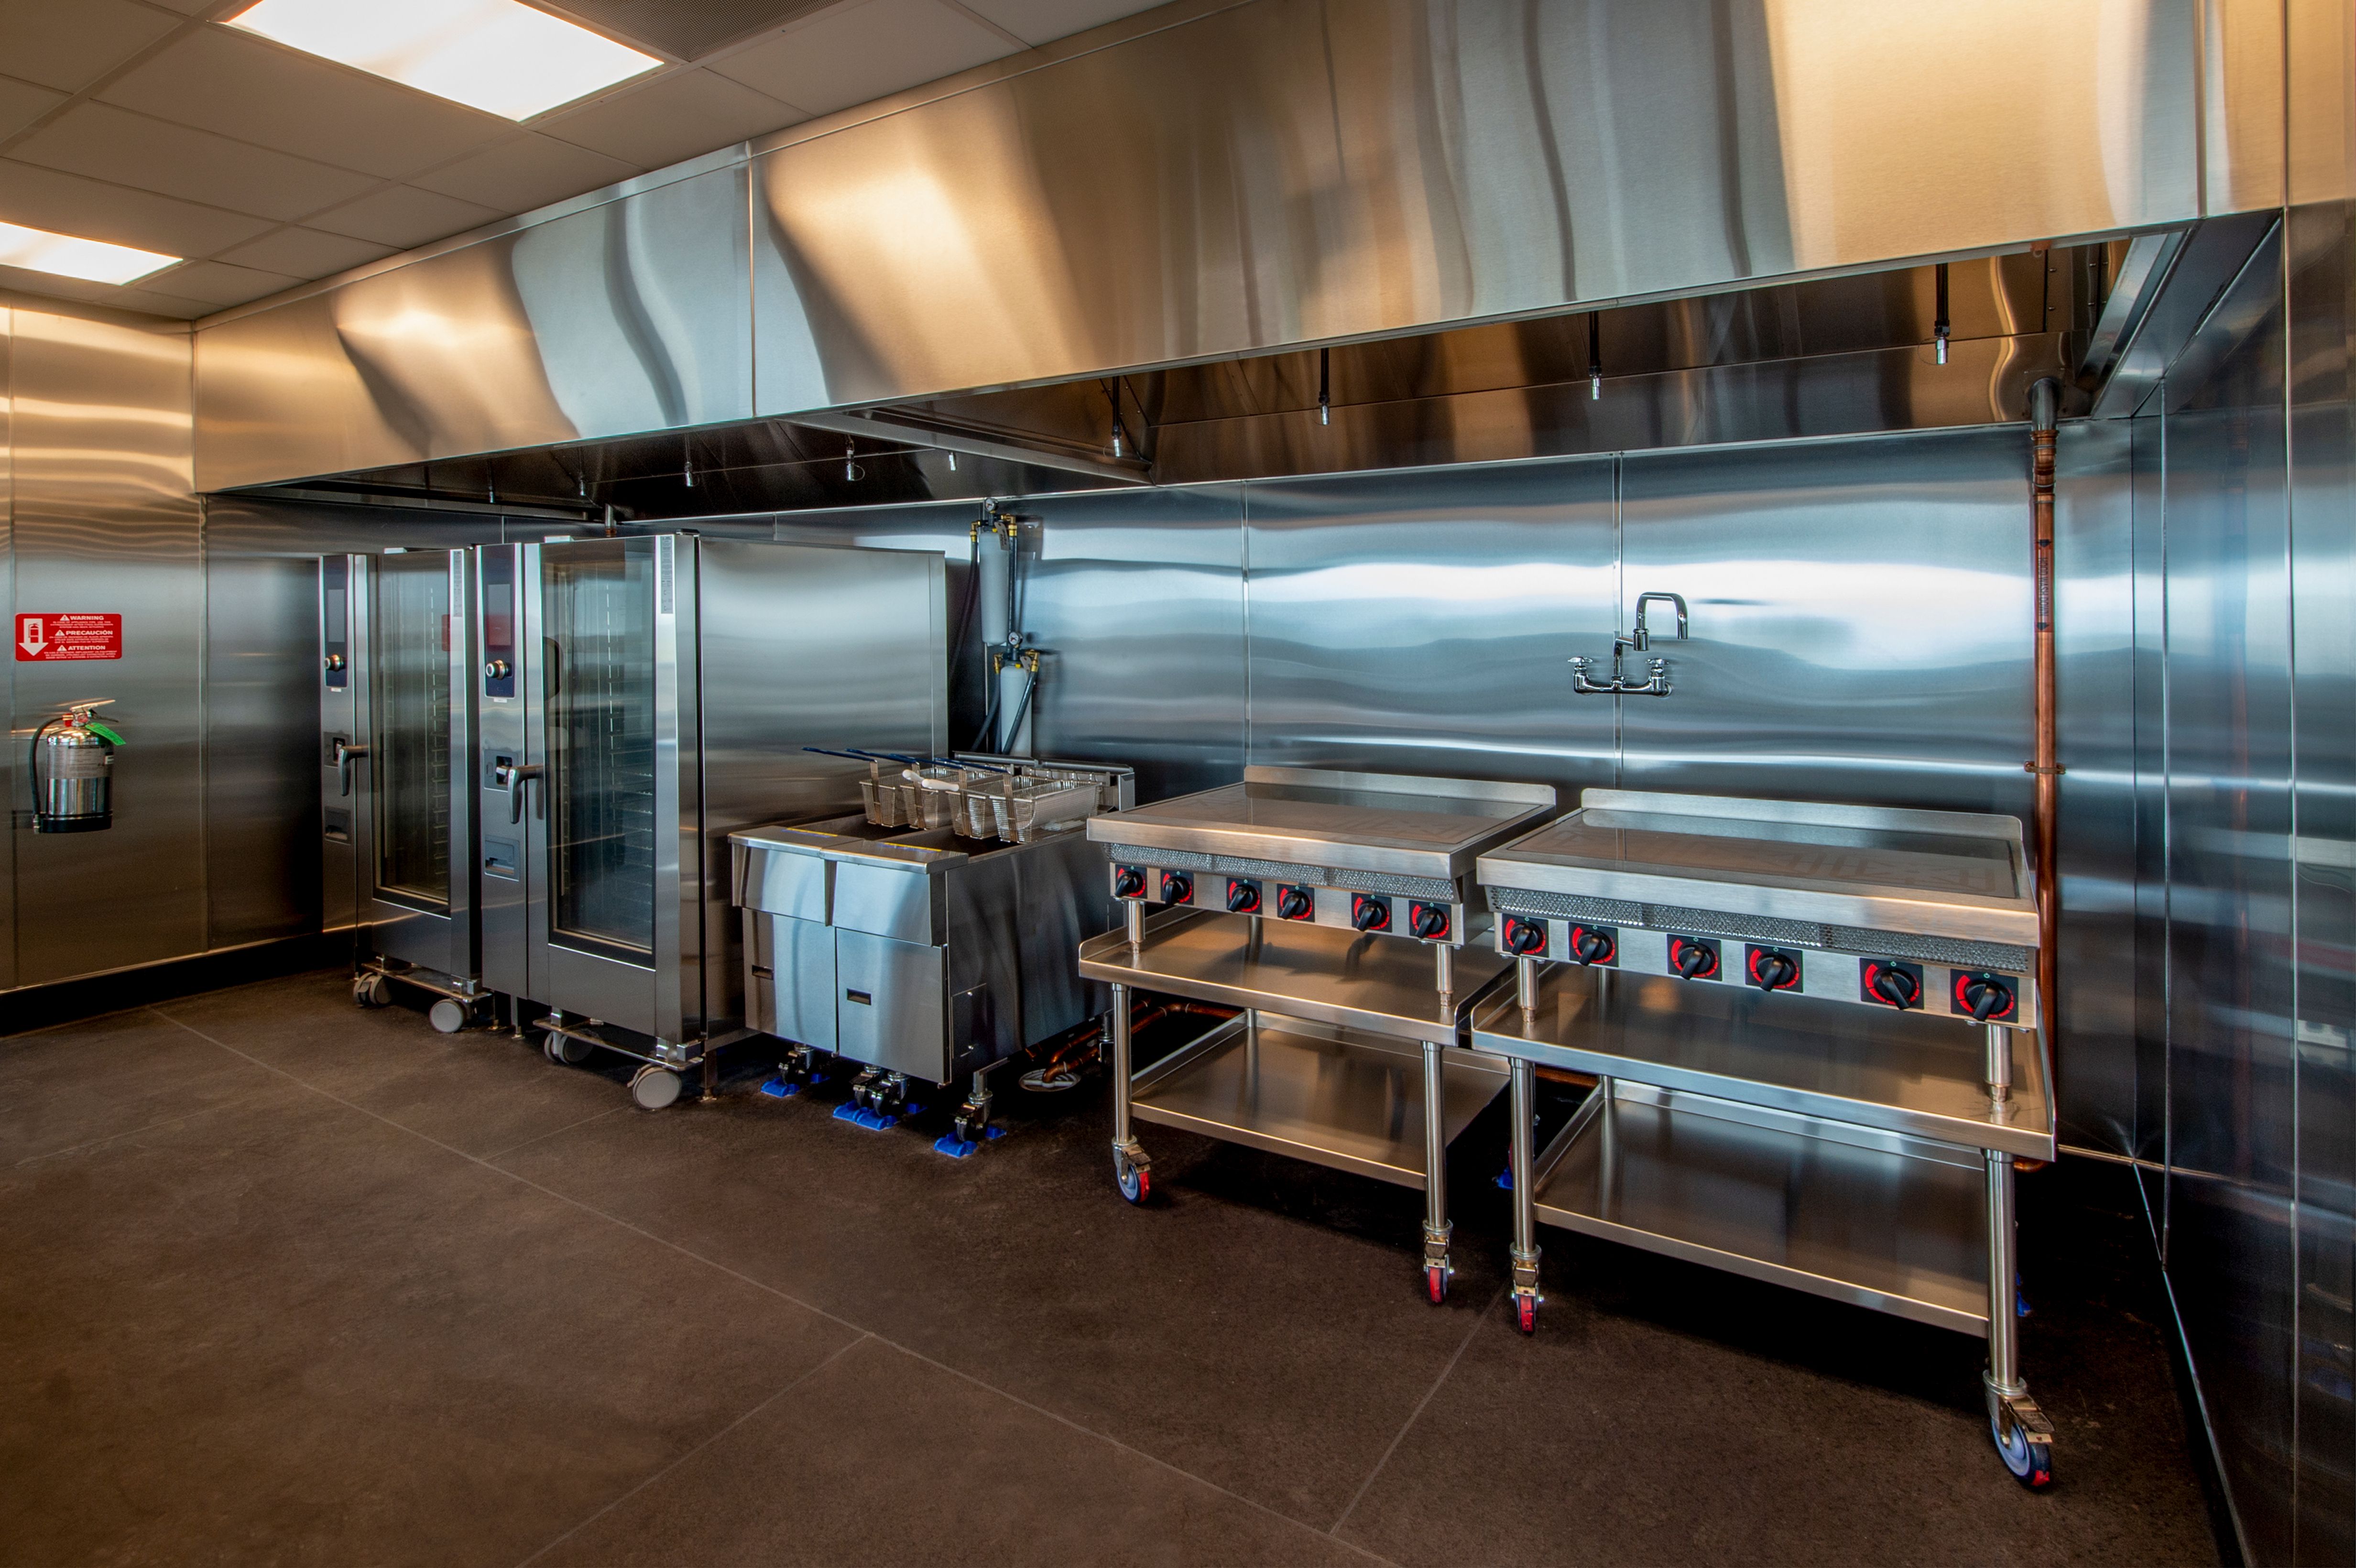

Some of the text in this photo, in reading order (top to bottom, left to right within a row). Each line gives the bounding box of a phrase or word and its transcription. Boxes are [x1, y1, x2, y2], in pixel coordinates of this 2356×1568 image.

[2039, 557, 2049, 616] HOOD WASH DOWN
